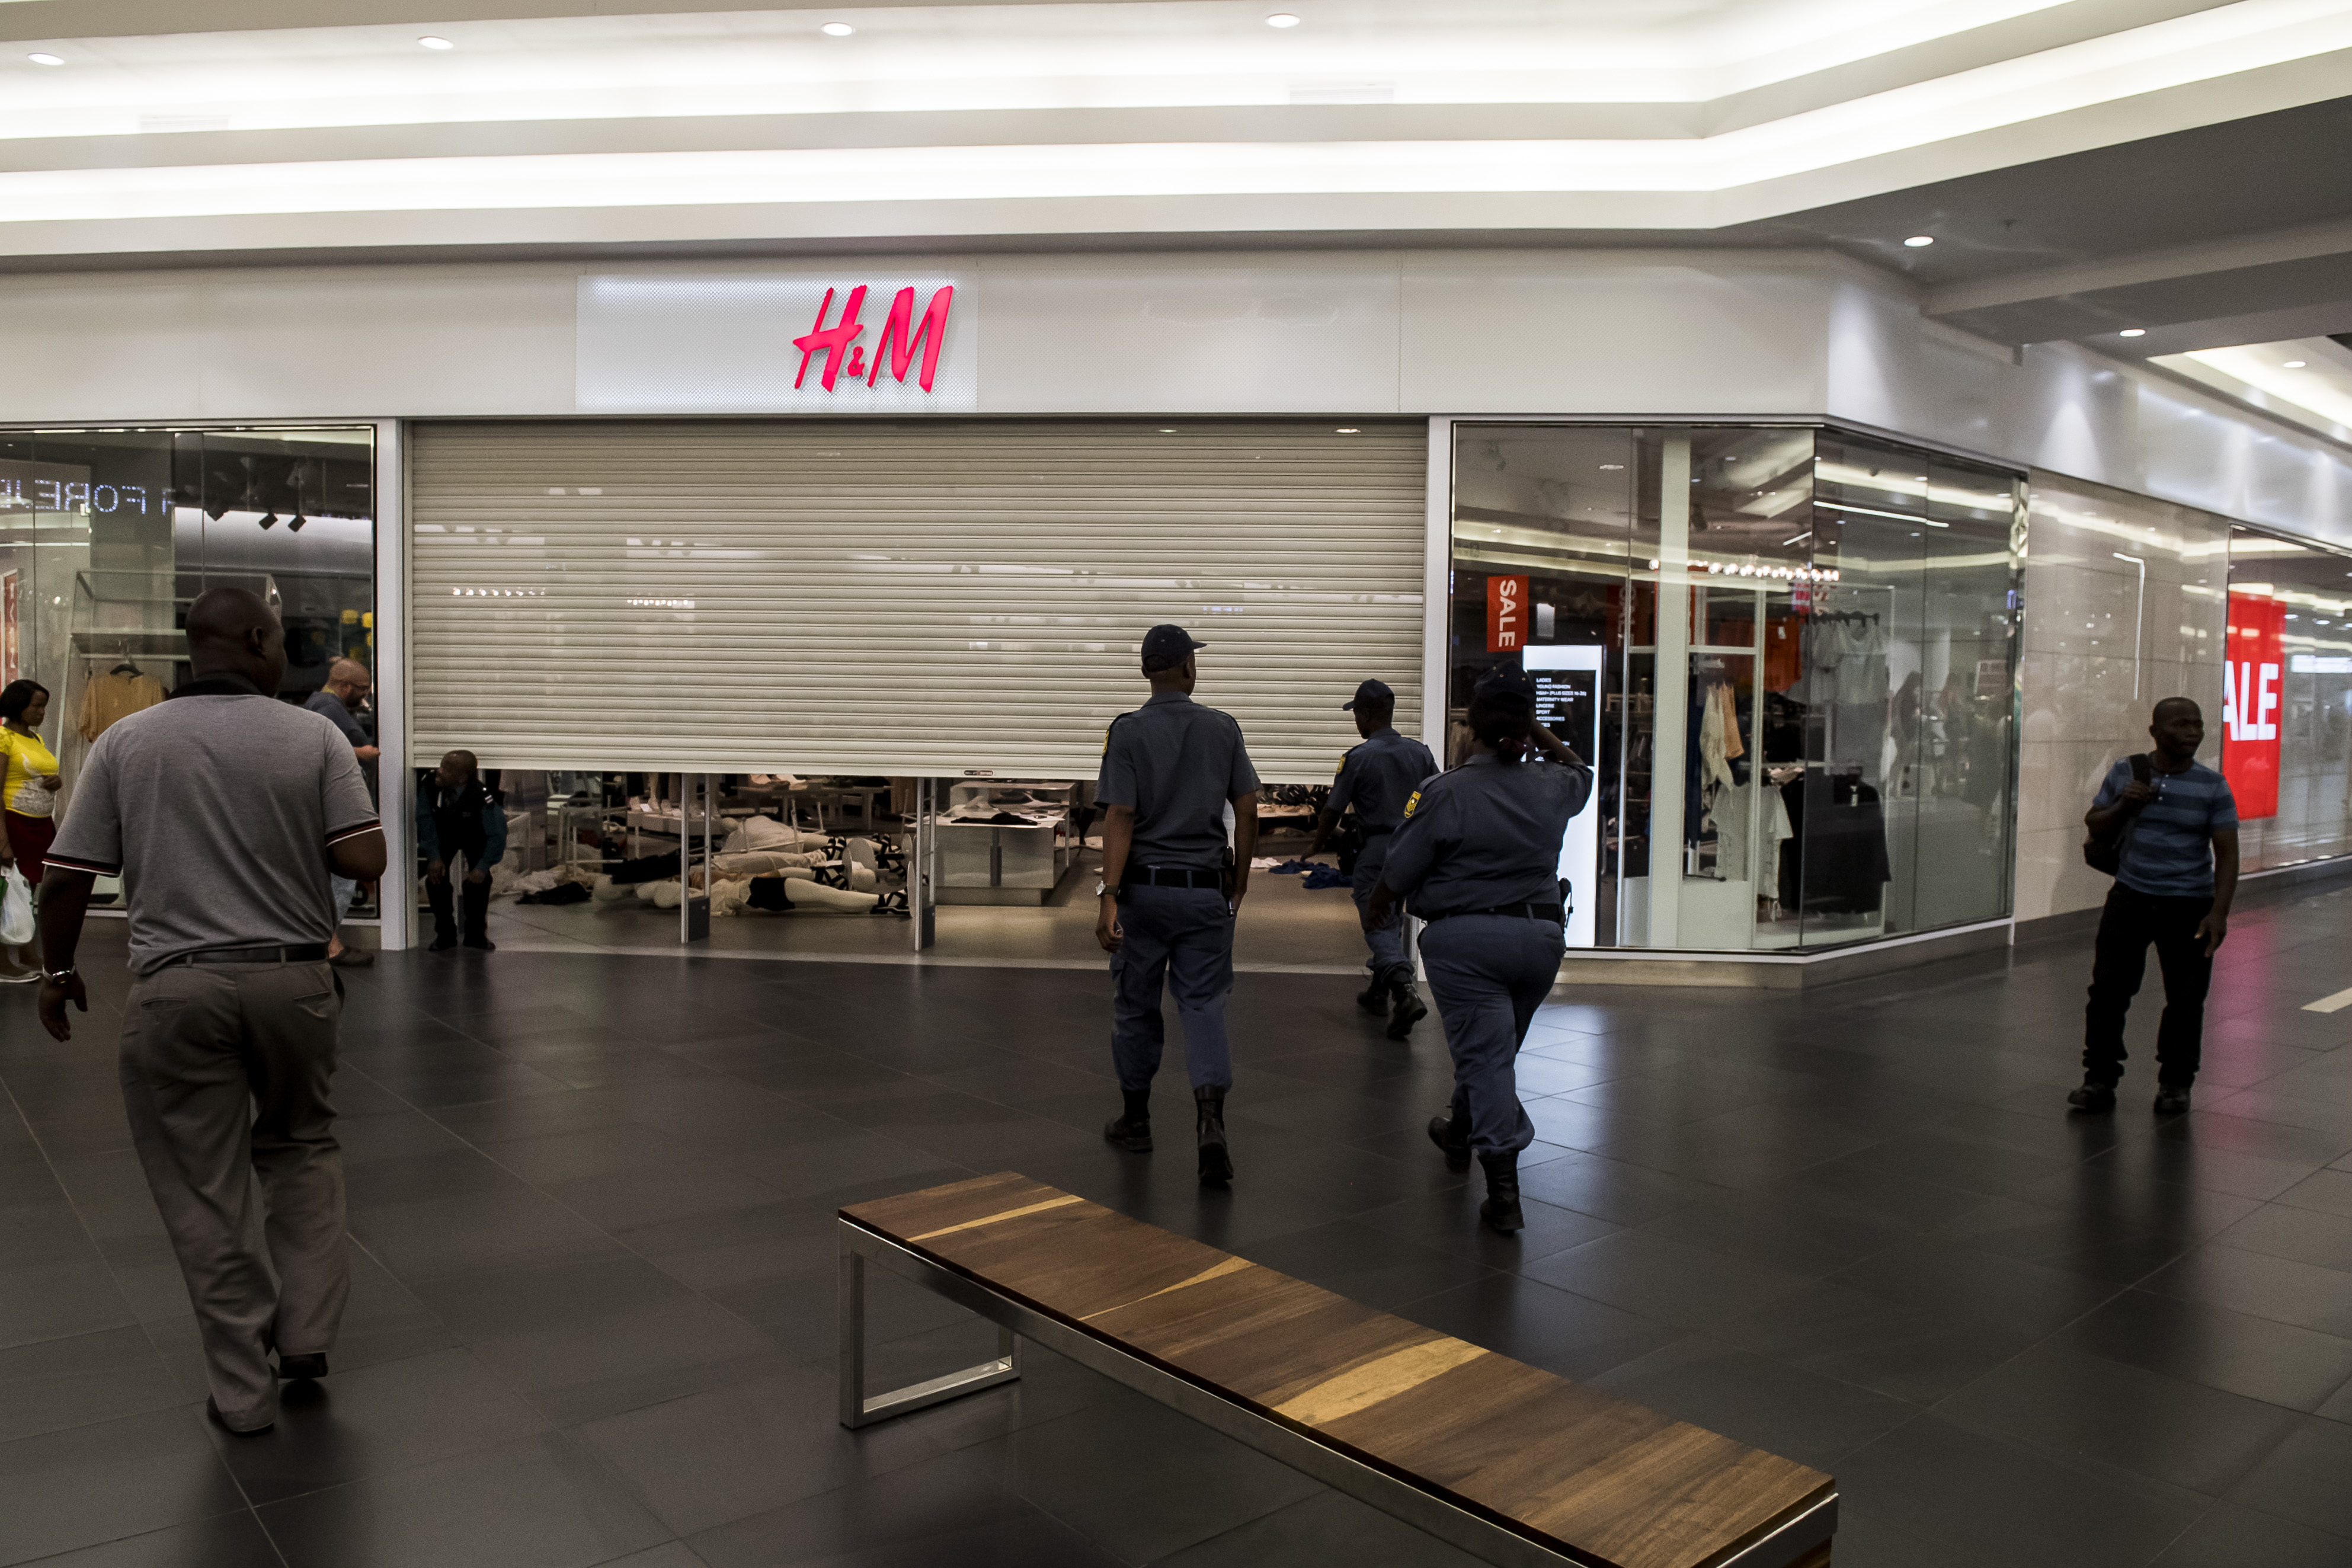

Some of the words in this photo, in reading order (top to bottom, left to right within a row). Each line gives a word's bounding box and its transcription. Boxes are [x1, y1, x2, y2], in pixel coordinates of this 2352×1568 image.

[792, 284, 953, 393] H&M
[1499, 580, 1517, 647] SALE
[2223, 660, 2279, 741] ALE
